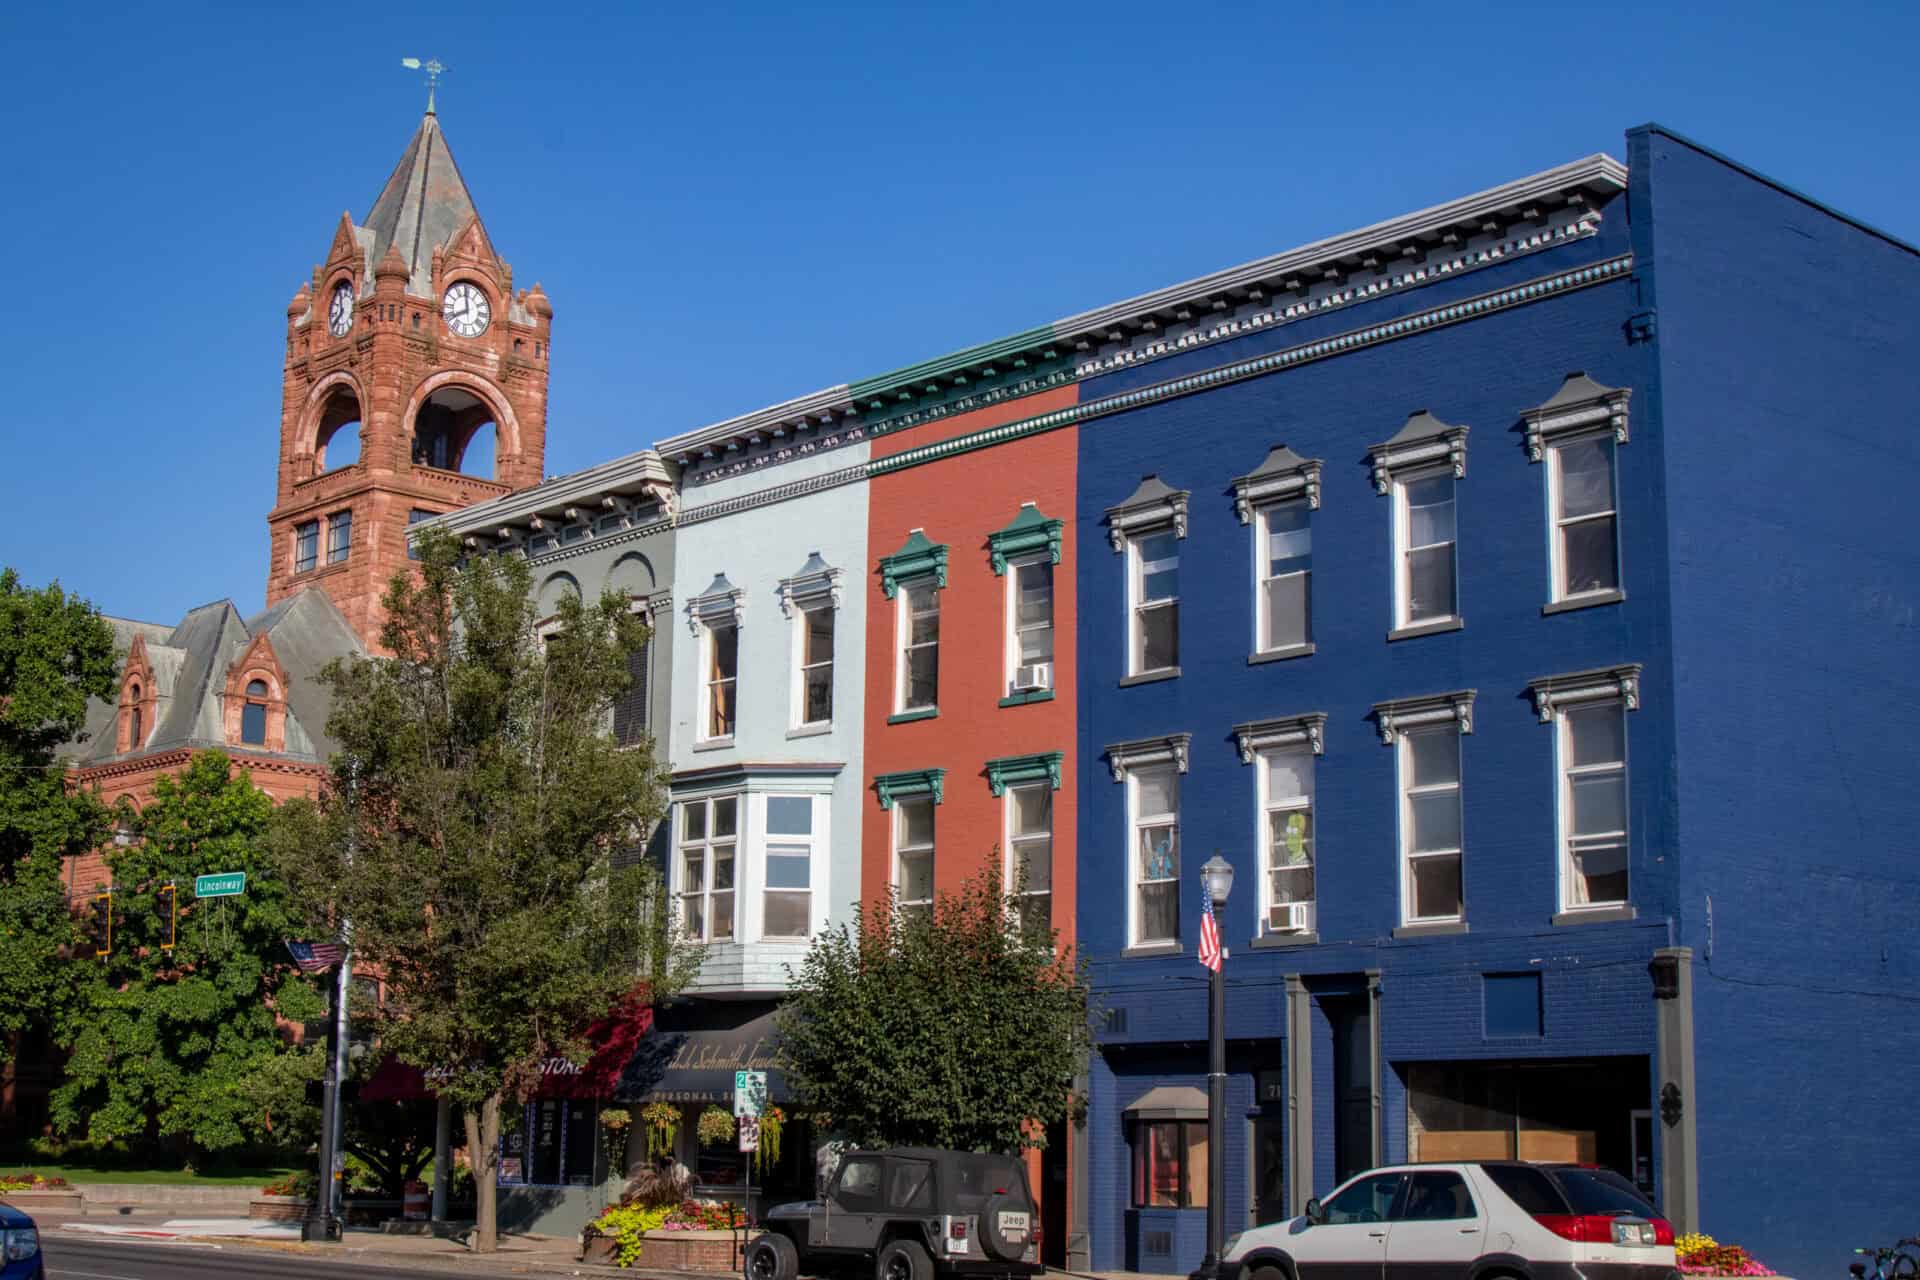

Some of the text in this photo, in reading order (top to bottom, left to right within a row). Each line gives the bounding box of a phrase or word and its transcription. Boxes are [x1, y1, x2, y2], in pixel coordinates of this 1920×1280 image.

[199, 879, 242, 892] Lincolnway
[738, 1074, 745, 1087] 2
[654, 1091, 714, 1100] PERSONAL
[1004, 1215, 1025, 1225] Jeep
